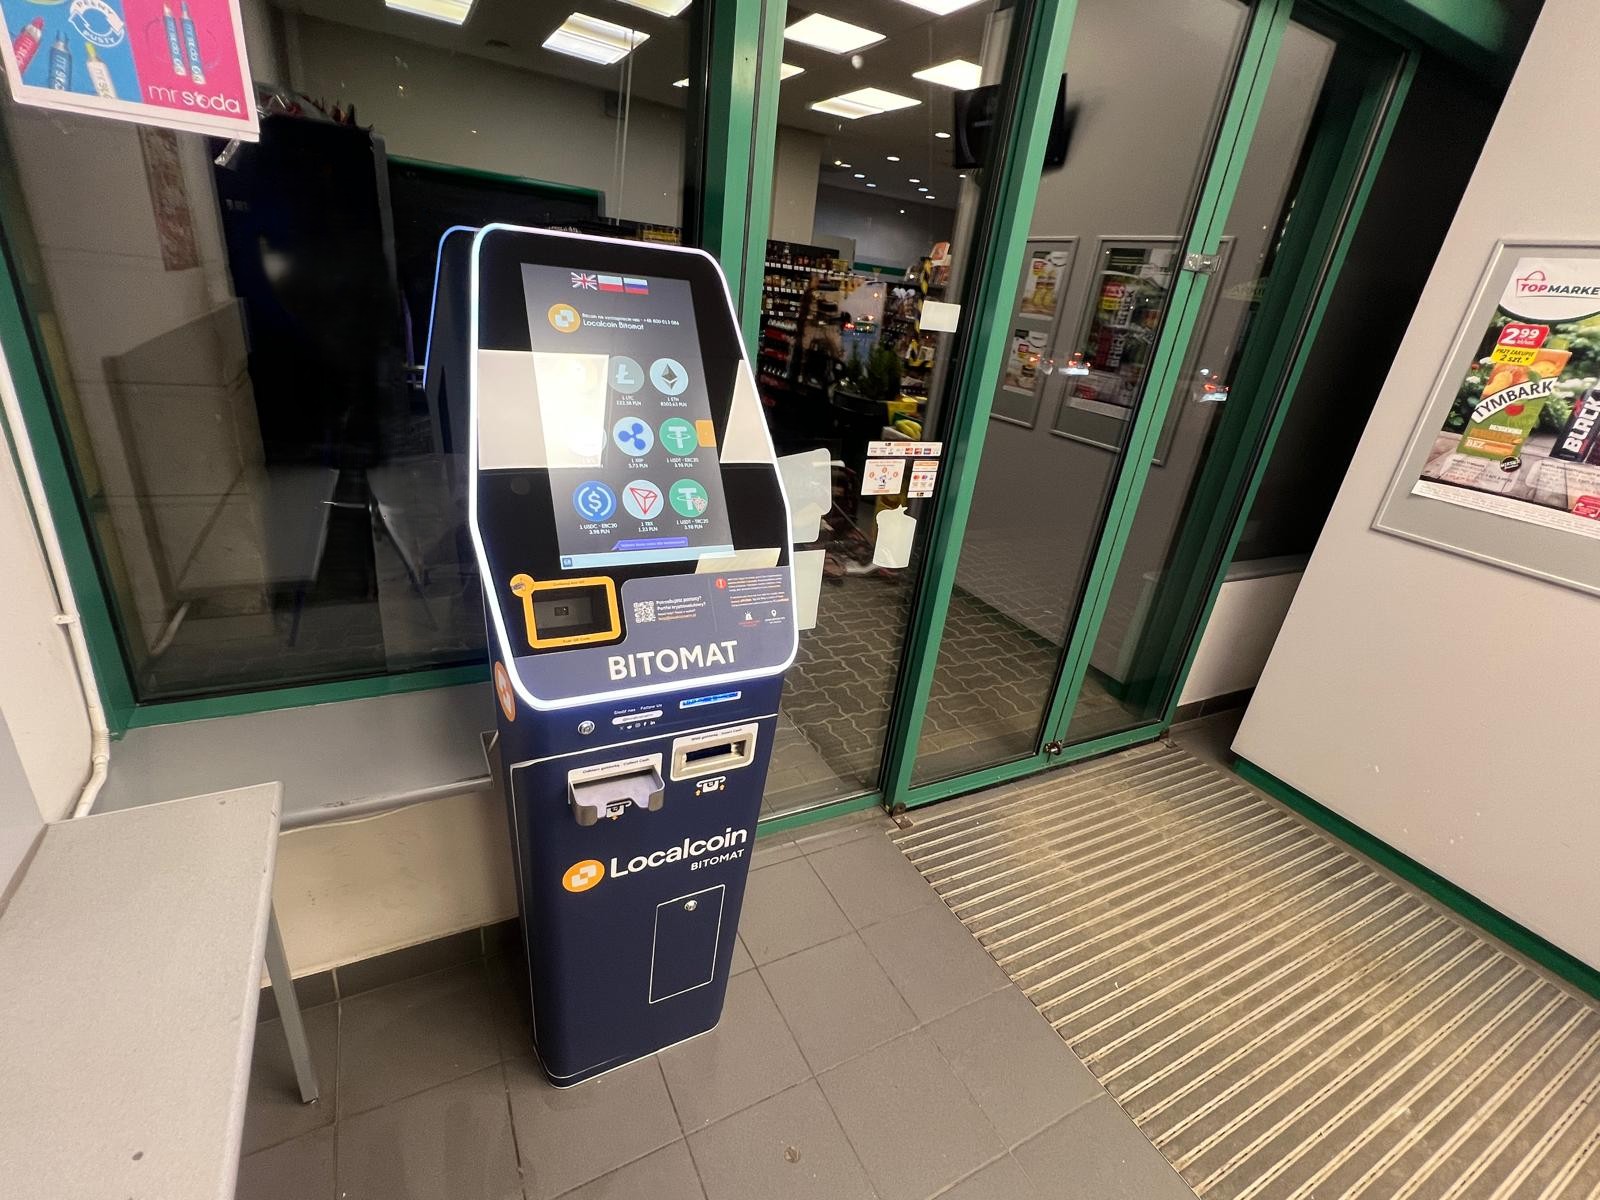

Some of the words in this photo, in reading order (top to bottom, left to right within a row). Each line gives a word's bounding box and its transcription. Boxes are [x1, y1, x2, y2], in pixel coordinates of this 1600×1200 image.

[148, 85, 179, 103] mr
[583, 318, 618, 329] Localcoin
[618, 321, 645, 330] Bitomat
[1500, 327, 1520, 345] 2
[1519, 328, 1540, 339] 99
[1474, 380, 1554, 418] TYMBARK
[607, 640, 738, 681] BITOMAT
[610, 827, 748, 878] Localcoin
[690, 848, 745, 871] BITOMAT
